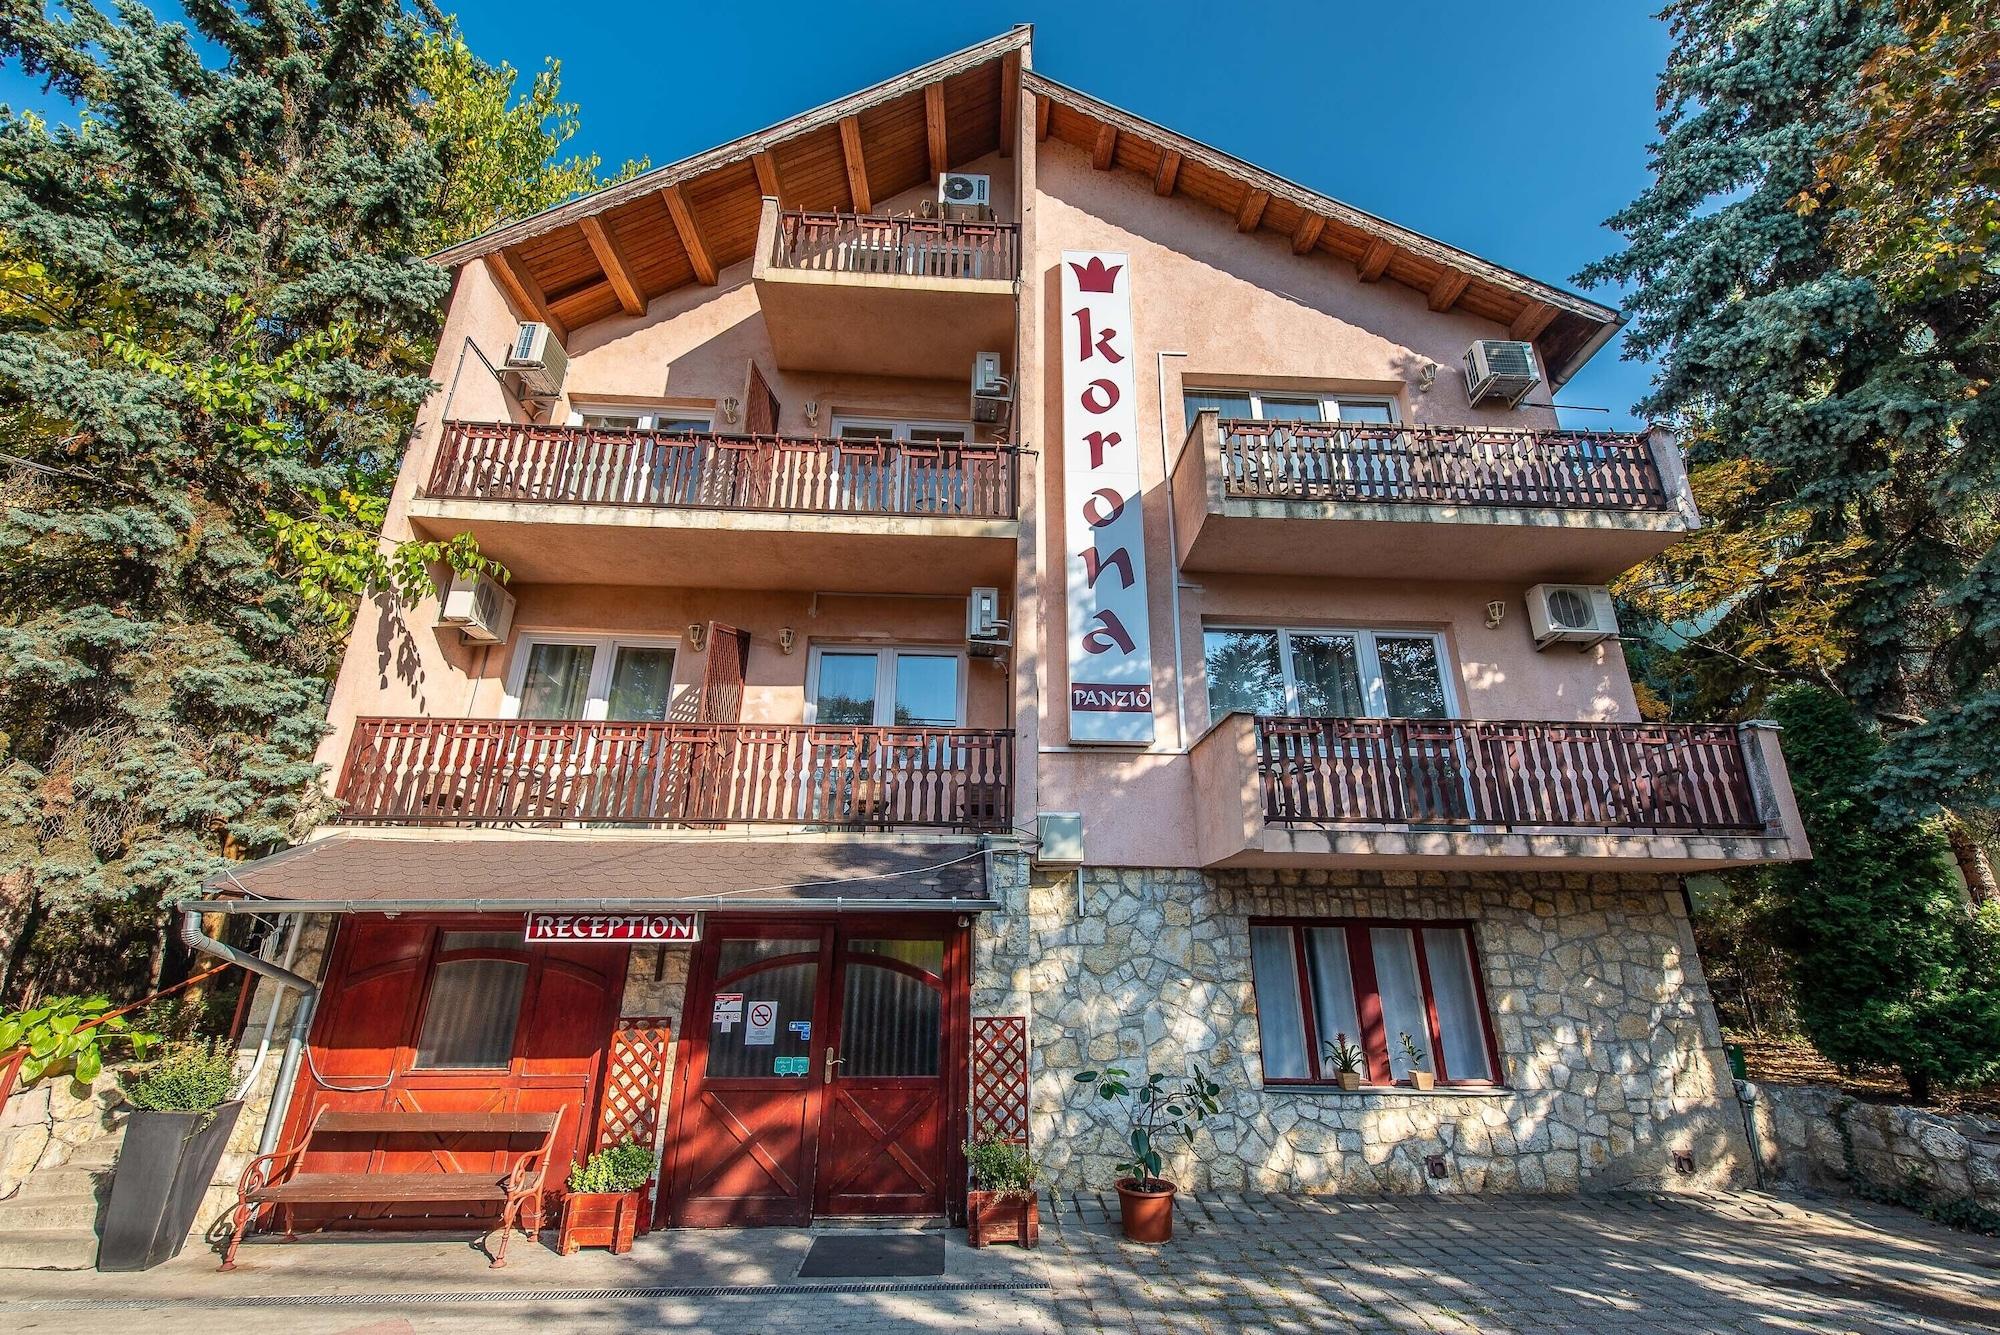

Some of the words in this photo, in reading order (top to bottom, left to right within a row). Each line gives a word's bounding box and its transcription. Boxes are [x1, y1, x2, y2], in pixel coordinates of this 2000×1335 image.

[1071, 307, 1137, 656] korona
[1073, 687, 1151, 708] PANZIÓ
[535, 915, 692, 939] RECEPTION
